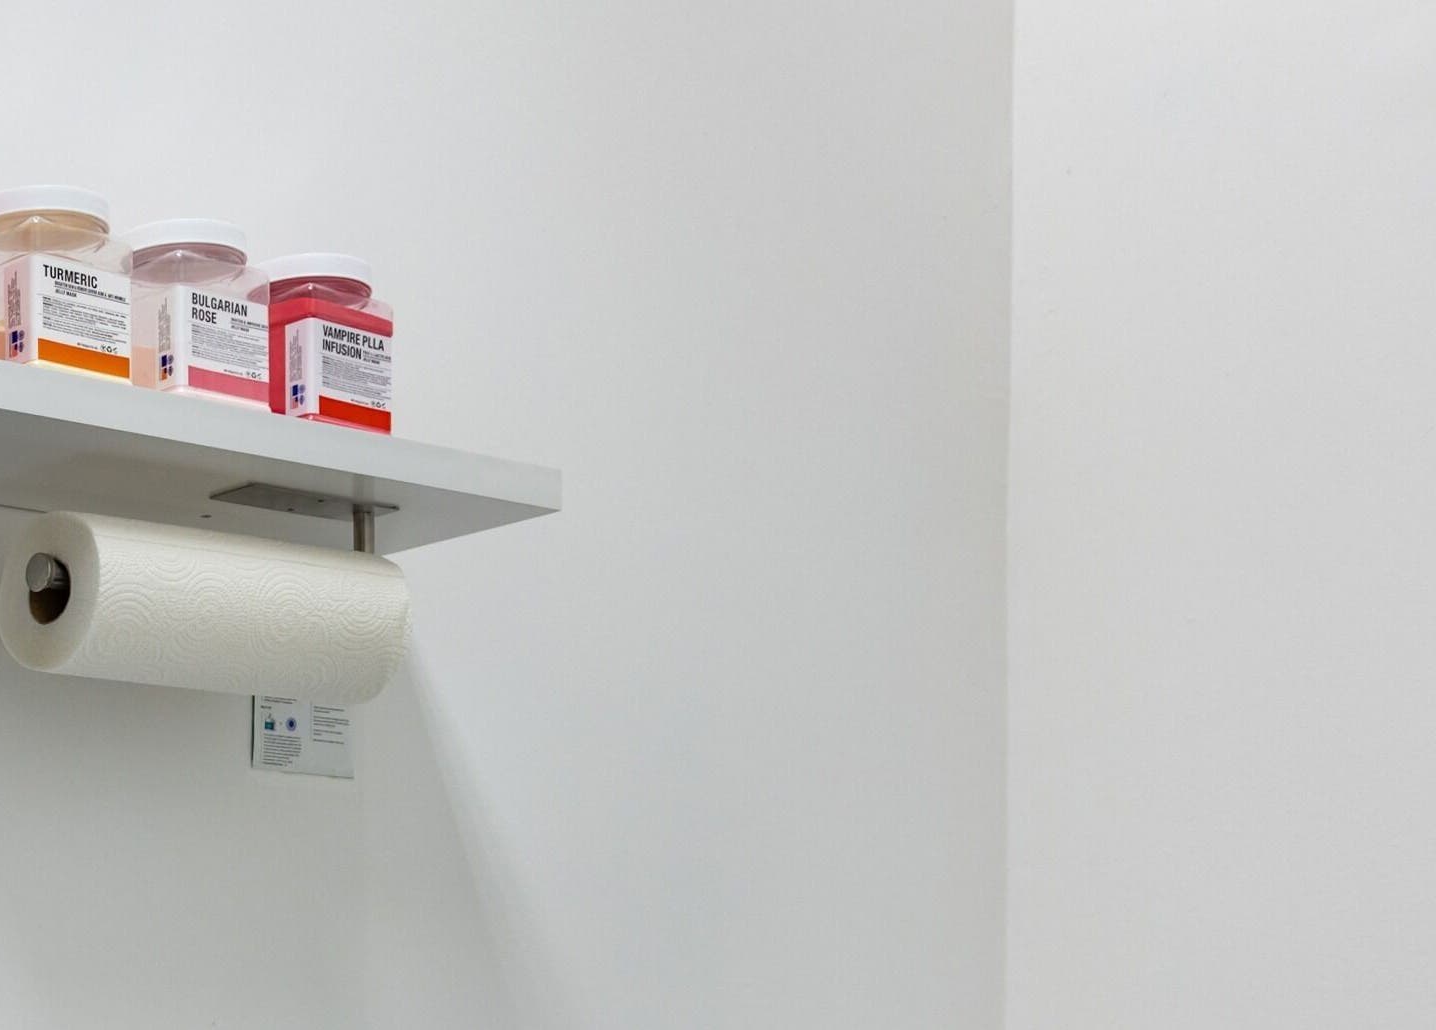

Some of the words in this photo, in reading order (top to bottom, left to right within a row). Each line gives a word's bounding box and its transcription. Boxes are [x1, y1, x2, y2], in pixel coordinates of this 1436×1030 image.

[42, 264, 99, 289] TURMERIC
[191, 292, 248, 317] BULGARIAN
[191, 307, 217, 325] ROSE
[322, 324, 361, 346] VAMPIRE
[361, 335, 385, 351] PLLA
[322, 338, 362, 360] INFUSION
